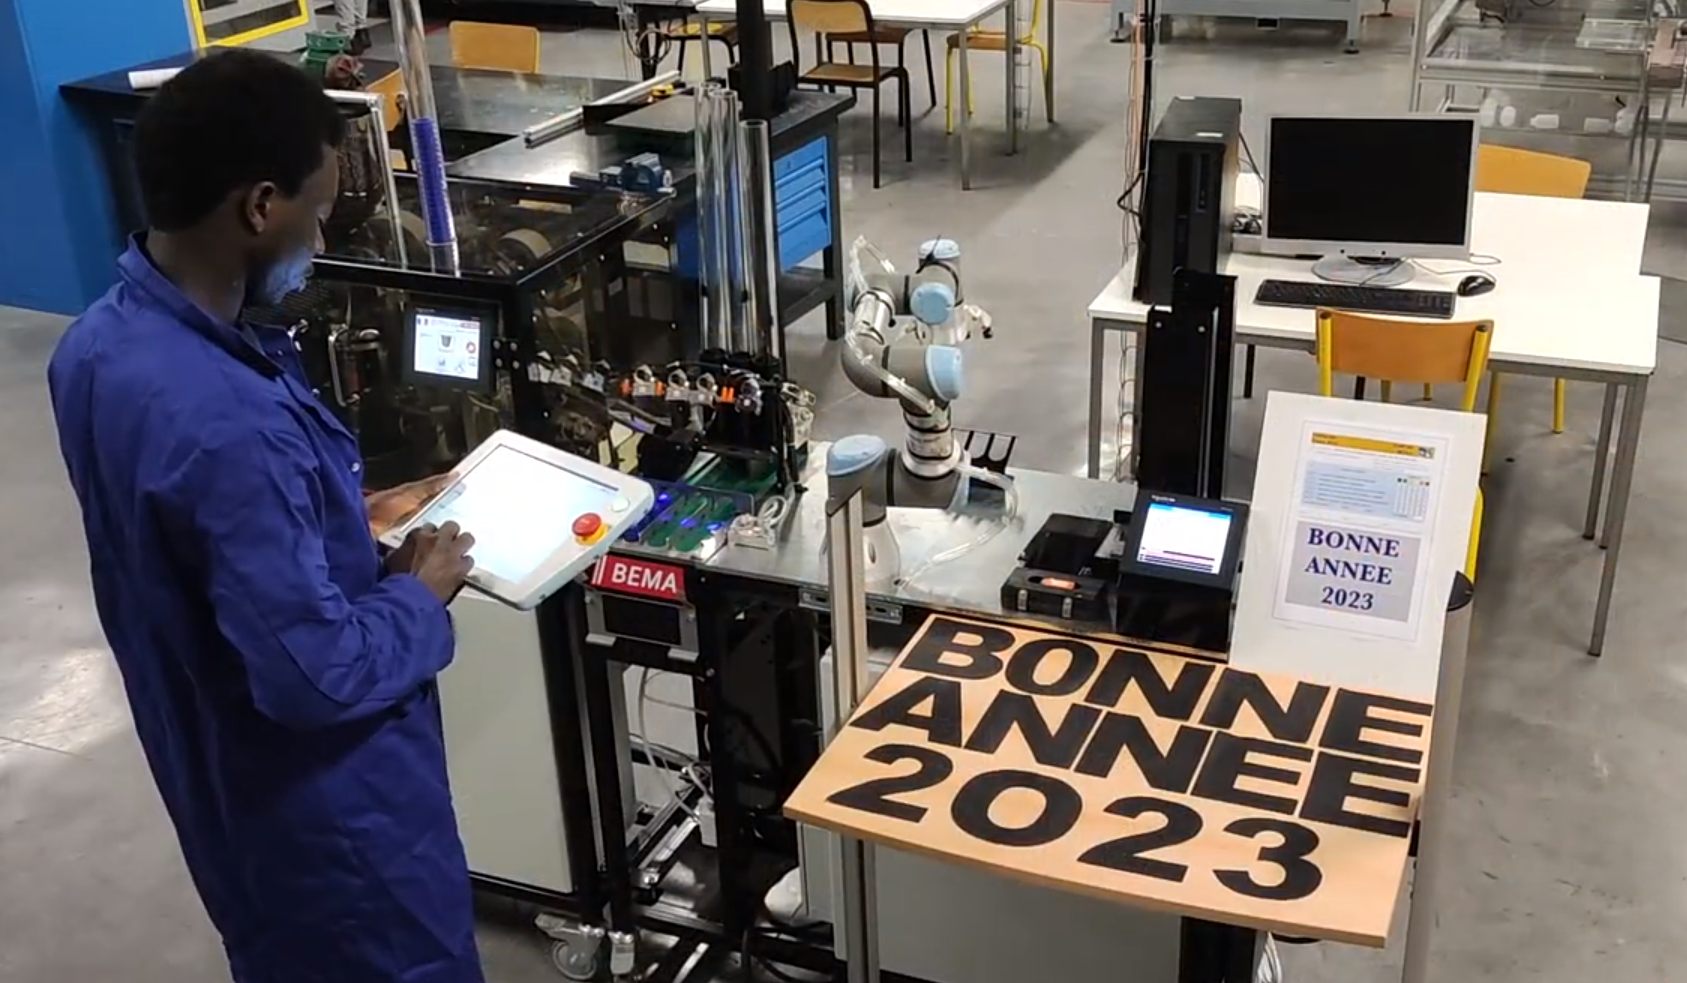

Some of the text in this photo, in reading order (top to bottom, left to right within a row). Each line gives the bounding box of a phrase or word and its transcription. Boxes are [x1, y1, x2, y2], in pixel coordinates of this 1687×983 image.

[1307, 527, 1400, 558] BONNE
[611, 562, 677, 594] BEMA
[1304, 556, 1393, 585] ANNEE
[1321, 586, 1374, 611] 2023
[899, 614, 1434, 764] BONNE
[848, 673, 1423, 839] ANNEE
[824, 743, 1324, 901] 2023
